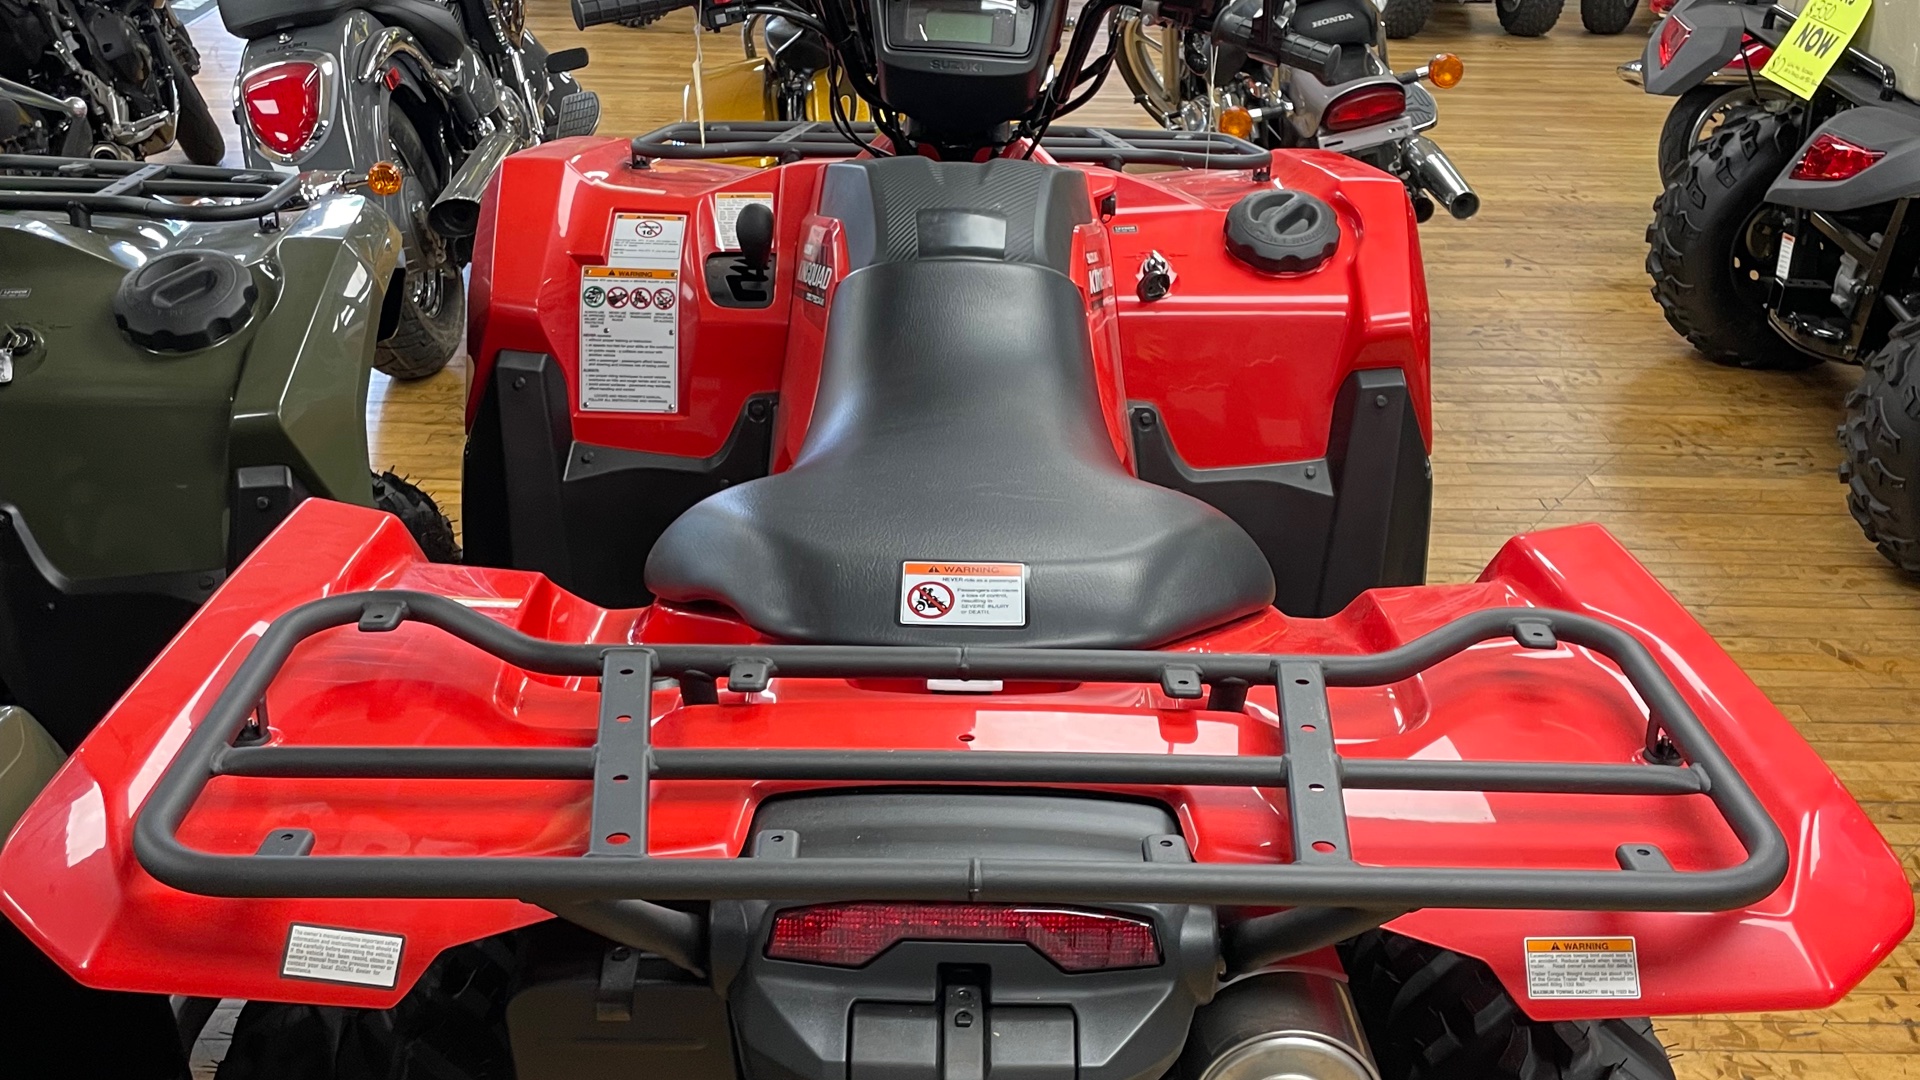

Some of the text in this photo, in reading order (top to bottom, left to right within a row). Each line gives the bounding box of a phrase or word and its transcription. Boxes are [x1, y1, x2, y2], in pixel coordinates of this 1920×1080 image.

[1312, 13, 1355, 28] HONDA
[1793, 22, 1840, 59] NOW
[266, 42, 308, 53] SUZUKI
[930, 60, 984, 73] SUZUKI
[1563, 942, 1609, 950] WARNING
